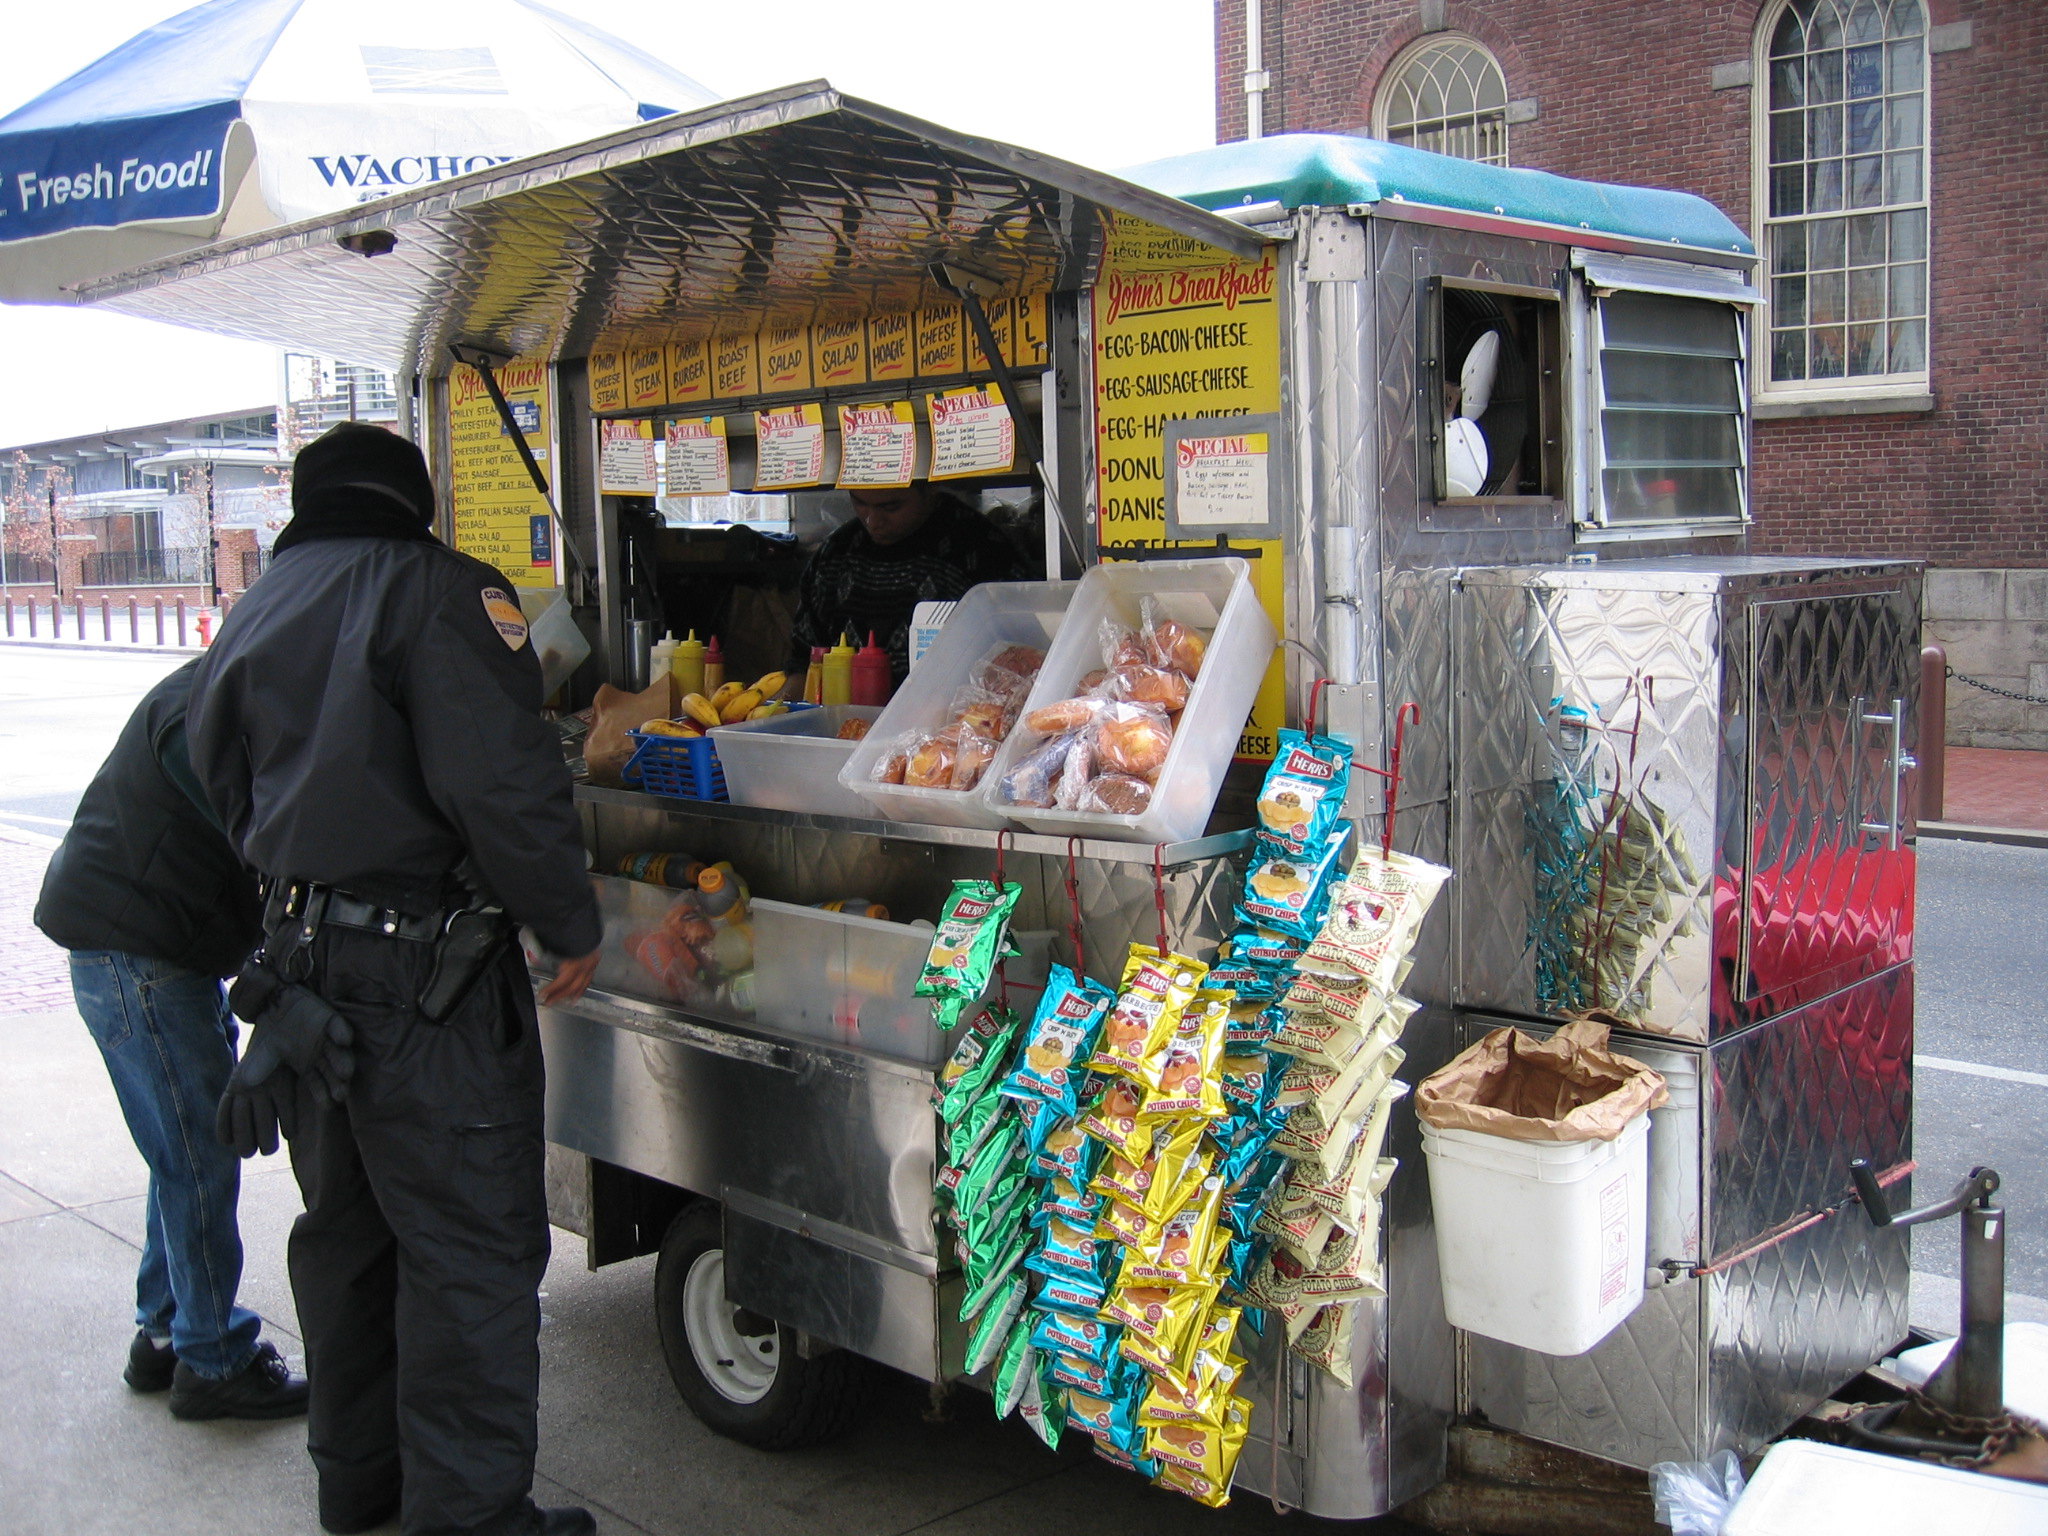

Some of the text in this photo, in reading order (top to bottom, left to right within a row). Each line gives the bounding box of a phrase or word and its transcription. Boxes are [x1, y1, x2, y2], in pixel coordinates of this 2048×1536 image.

[308, 155, 521, 186] WACHO
[18, 150, 213, 211] Fresh Food!
[1107, 257, 1274, 325] John's Breakfast
[923, 305, 950, 327] HAM
[920, 322, 956, 349] CHEESE
[973, 327, 1007, 359] HGIE
[1105, 323, 1249, 359] EGG-BACON-CHEESE
[718, 346, 749, 371] ROAST
[822, 342, 859, 373] SALAD
[873, 338, 905, 368] HOAGIE
[921, 343, 955, 368] HOAGIE
[768, 350, 802, 377] SALAD
[501, 363, 543, 396] Lunch
[593, 373, 620, 389] CHEESE
[634, 370, 661, 394] STEAK
[673, 360, 705, 389] BURGER
[719, 366, 746, 389] BEEF
[1107, 367, 1249, 400] EGG-SAUSAGE-CHEESE
[597, 389, 619, 403] STEAK
[453, 408, 474, 418] PHILLY
[932, 391, 991, 423] SPECIAL
[453, 419, 498, 431] CHEESESTEAK
[843, 410, 897, 434] SPECIAL
[454, 433, 490, 442] HAMBURGER
[454, 445, 501, 456] CHEESEBURGER
[1178, 438, 1248, 467] SPECIAL
[486, 457, 498, 465] HOT
[501, 455, 514, 463] DOG
[456, 469, 499, 480] HOT SAUSAGE
[1108, 457, 1165, 482] DONU
[456, 484, 475, 493] ROAST
[478, 483, 492, 491] BEEF
[456, 497, 474, 505] GYRO
[1109, 498, 1165, 522] DANIS
[458, 506, 531, 518] SWEET ITALIAN SAUSAGE
[458, 521, 487, 530] KIELBASA
[458, 533, 500, 542] TUNA SALAD
[487, 545, 510, 553] SALAD
[1237, 736, 1271, 754] EESE
[1292, 755, 1329, 776] HERR'S
[1245, 903, 1298, 921] POTATO CHIPS
[1249, 948, 1277, 957] POTATO
[1305, 943, 1342, 961] POTATO
[1345, 952, 1377, 973] CHIPS
[1210, 971, 1258, 981] POTATO CHIPS
[1064, 999, 1090, 1016] HERR'S
[1288, 985, 1357, 1019] POTATO CHIPS
[1179, 1016, 1201, 1029] RR'S
[1172, 1039, 1202, 1048] BECUE
[1227, 1030, 1272, 1040] TATO CHIPS
[1118, 1059, 1139, 1072] CHIPS
[1040, 1084, 1062, 1097] CHIPS
[1230, 1085, 1256, 1103] CHIPS
[1147, 1099, 1201, 1111] POTATO CHIPS
[1106, 1130, 1125, 1146] CHIPS
[1314, 1193, 1344, 1212] CHIPS
[1067, 1208, 1091, 1219] CHIPS
[1042, 1251, 1091, 1270] POTATO CHIPS
[1162, 1270, 1183, 1279] CHIP
[1302, 1278, 1363, 1291] POTATO CHIPS
[1050, 1288, 1100, 1306] POTATO CHIPS
[1109, 1305, 1155, 1335] POTATO CHIPS
[1047, 1328, 1092, 1352] POTATO CHIPS
[1055, 1370, 1102, 1392] POTATO CHIPS
[1150, 1407, 1175, 1418] POTATO
[1150, 1448, 1177, 1462] POTATO
[1179, 1458, 1202, 1471] CHIPS
